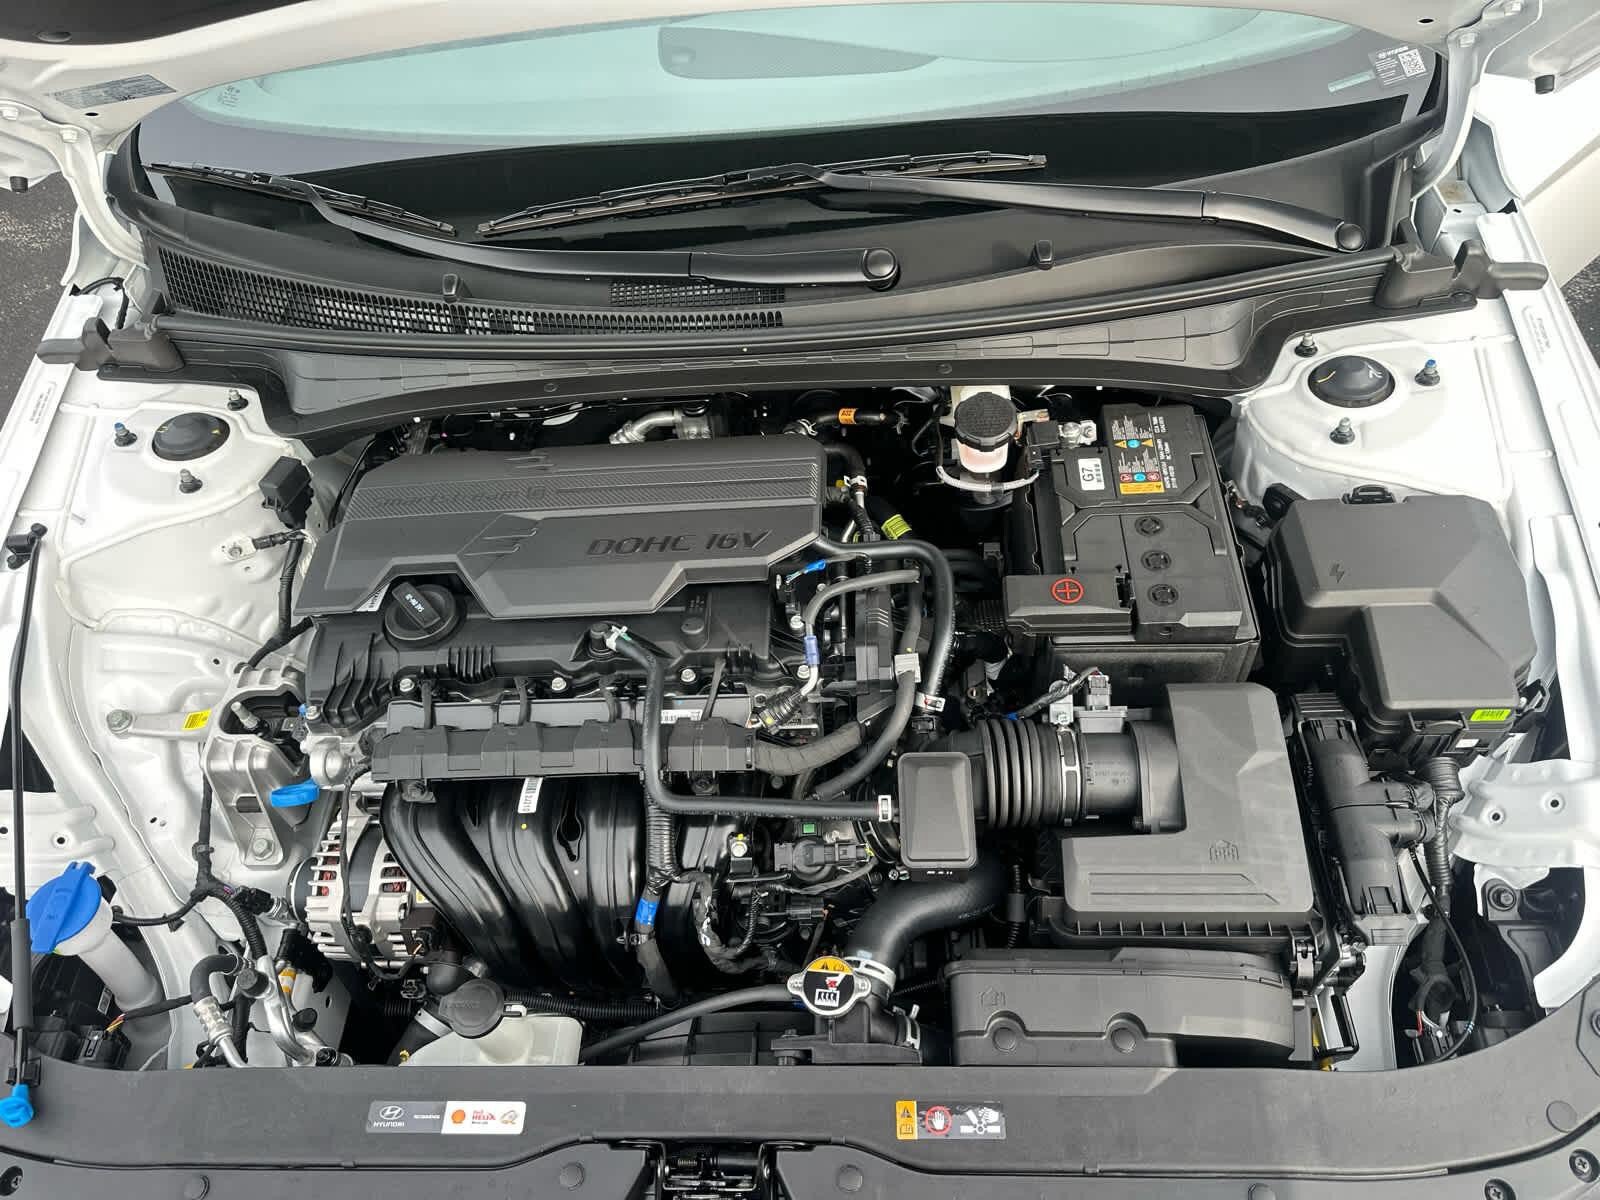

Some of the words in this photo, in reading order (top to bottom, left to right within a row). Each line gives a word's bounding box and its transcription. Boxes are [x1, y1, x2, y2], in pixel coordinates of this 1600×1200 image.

[1081, 467, 1094, 481] G7
[586, 534, 696, 555] DOHC
[706, 529, 772, 550] 16V
